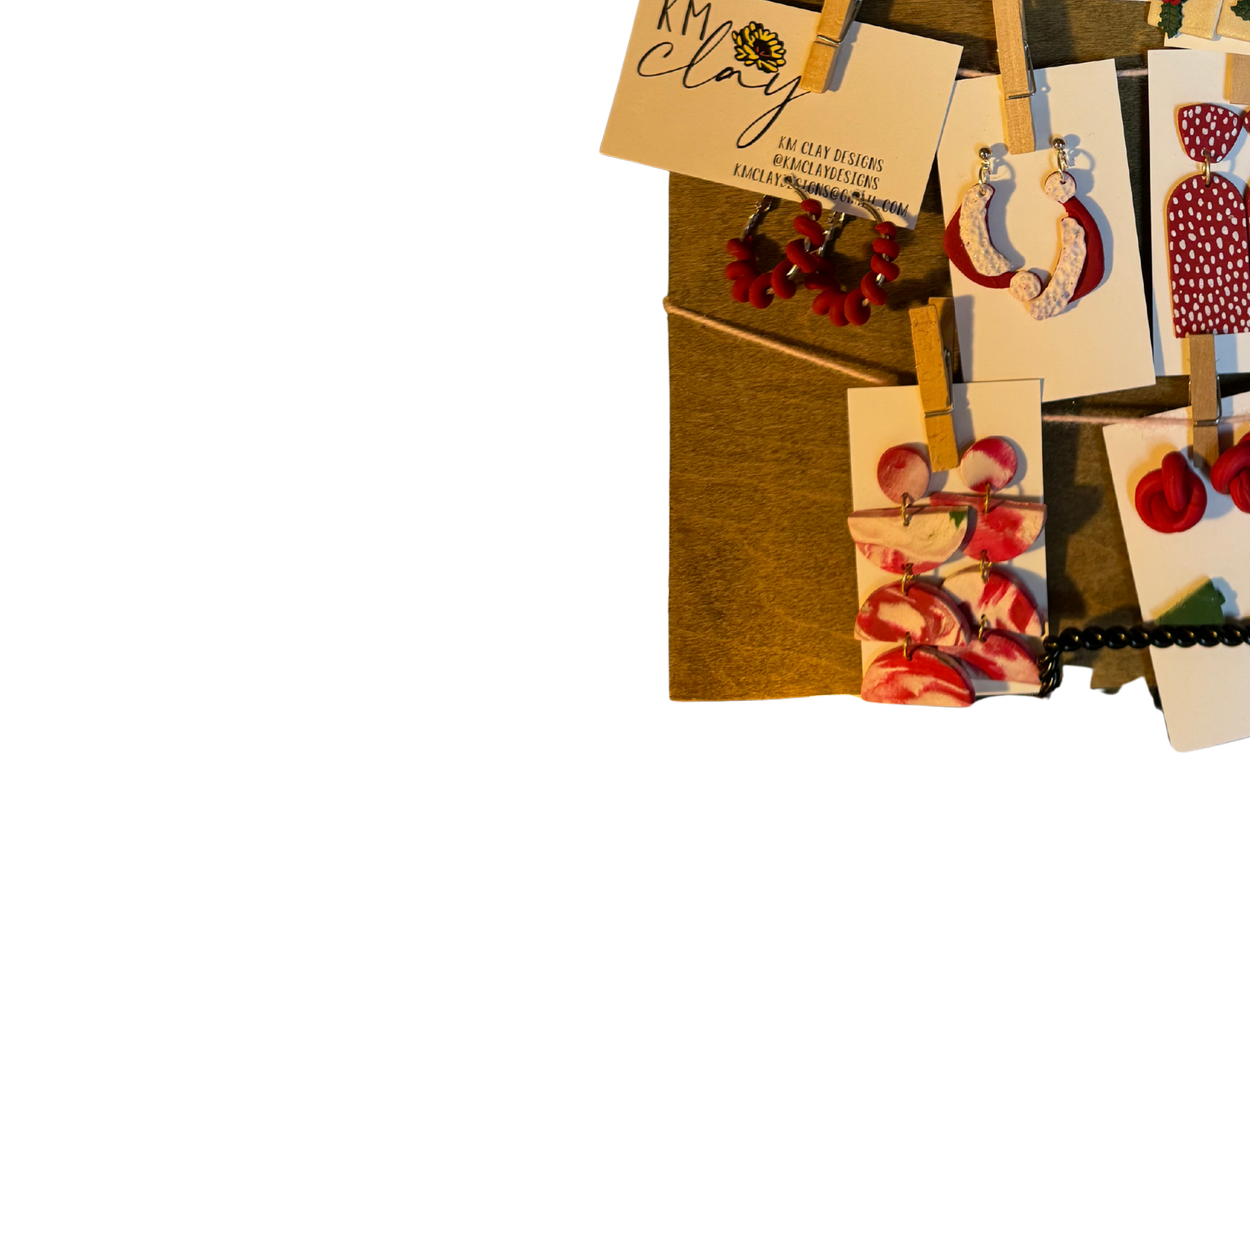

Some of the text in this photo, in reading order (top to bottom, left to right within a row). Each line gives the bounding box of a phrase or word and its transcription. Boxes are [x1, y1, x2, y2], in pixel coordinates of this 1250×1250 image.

[772, 153, 881, 191] @KMCLAYDESIGNS
[777, 135, 885, 173] KM CLAY DESIGNS
